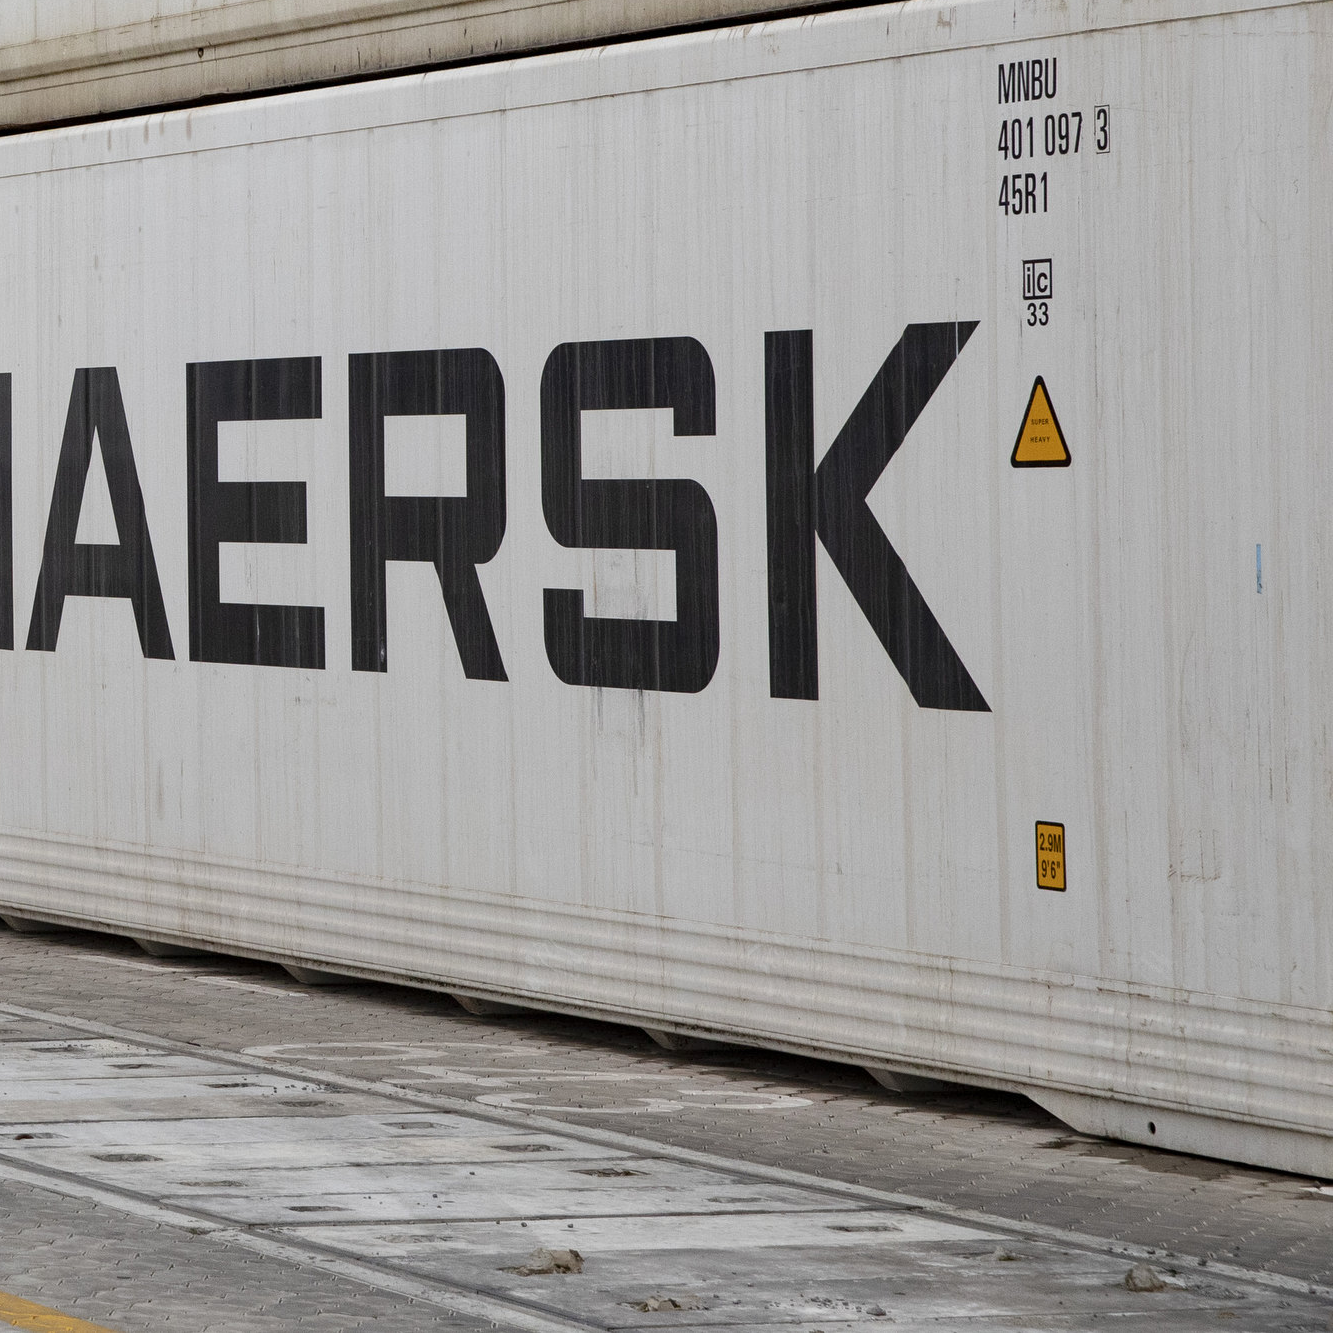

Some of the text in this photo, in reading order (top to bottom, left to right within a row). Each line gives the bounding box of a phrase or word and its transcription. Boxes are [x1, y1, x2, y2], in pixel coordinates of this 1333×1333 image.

[997, 56, 1058, 105] MNBU
[997, 107, 1110, 161] 401 097 3
[998, 170, 1050, 216] 45R1
[1026, 302, 1050, 327] 33
[1030, 417, 1050, 426] SUPER
[1029, 435, 1051, 444] HEAVY
[1038, 832, 1063, 854] 2.9M
[1041, 858, 1062, 880] 9'6"
